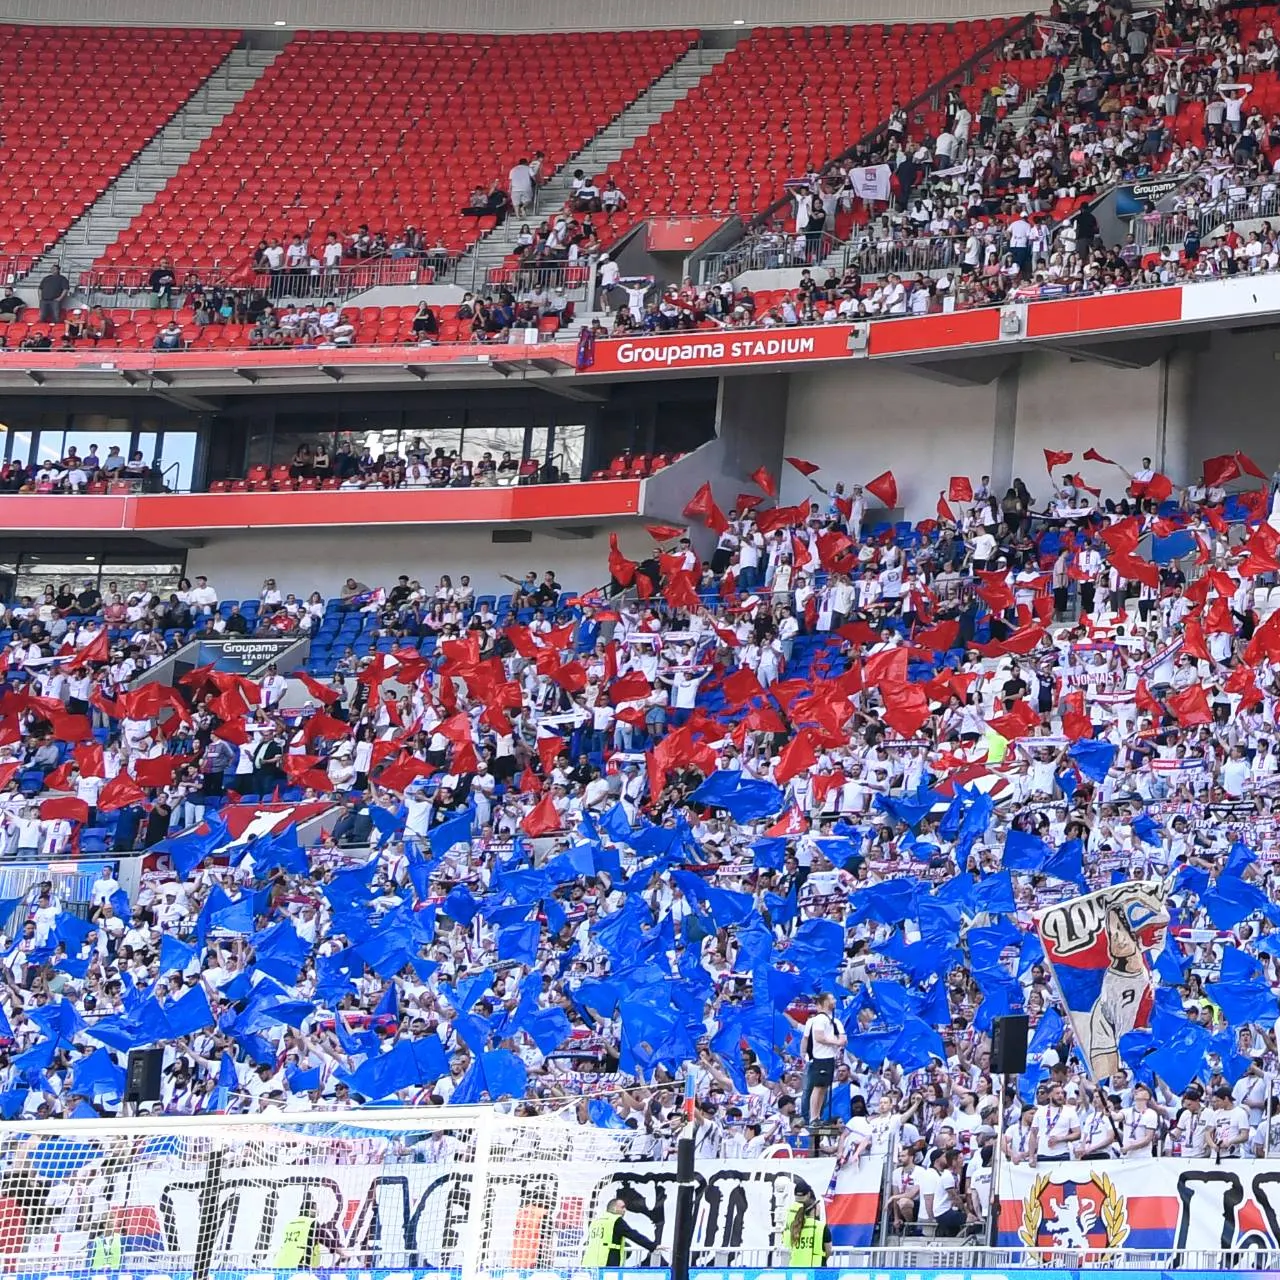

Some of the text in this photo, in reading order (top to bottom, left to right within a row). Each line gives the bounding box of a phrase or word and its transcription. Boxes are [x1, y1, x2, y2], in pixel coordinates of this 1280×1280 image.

[616, 337, 815, 364] Groupama STADIUM
[222, 642, 278, 654] Groupama
